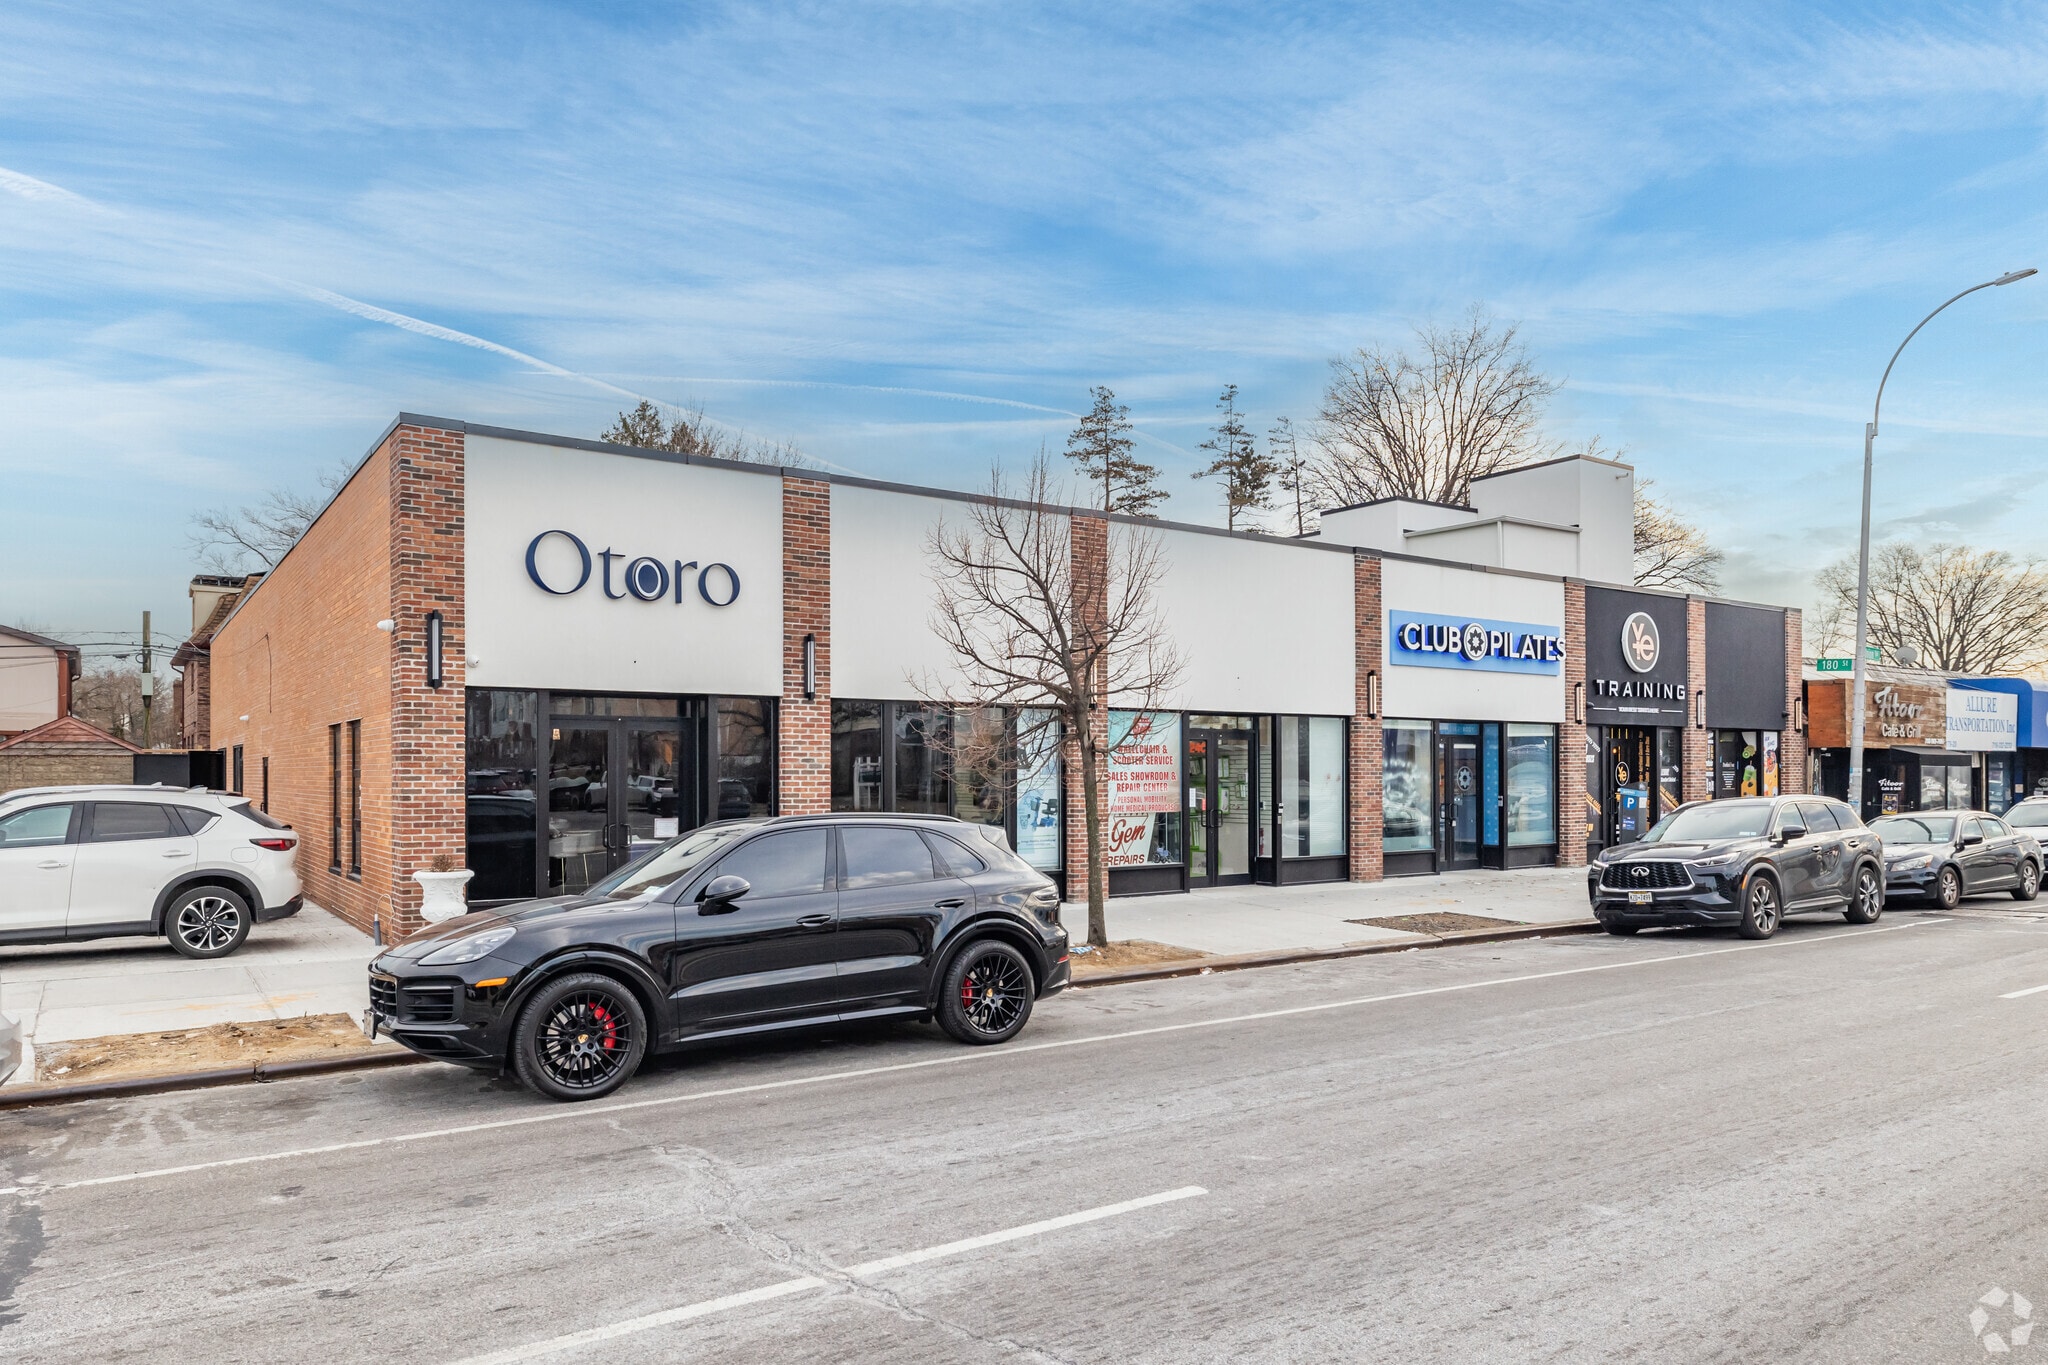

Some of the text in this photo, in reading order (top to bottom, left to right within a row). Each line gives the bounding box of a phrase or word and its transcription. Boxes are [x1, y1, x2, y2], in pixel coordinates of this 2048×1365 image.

[525, 530, 741, 606] Otoro
[1403, 622, 1566, 661] CLUB PILATES
[1822, 660, 1839, 670] 180
[1596, 679, 1686, 700] TRAINING
[1966, 696, 1997, 713] ALLURE
[1946, 716, 2005, 732] TRANSPORTATION
[1900, 725, 1906, 737] &
[1162, 745, 1168, 754] &
[1113, 756, 1173, 765] SCOOTER SERVICE
[1107, 772, 1177, 781] SALES SHOWROOM &
[1117, 783, 1168, 792] REPAIR CENTER
[1117, 796, 1143, 804] PERSONAL
[1627, 797, 1635, 808] P
[1109, 819, 1146, 852] Gem
[1108, 854, 1145, 866] REPAIRS
